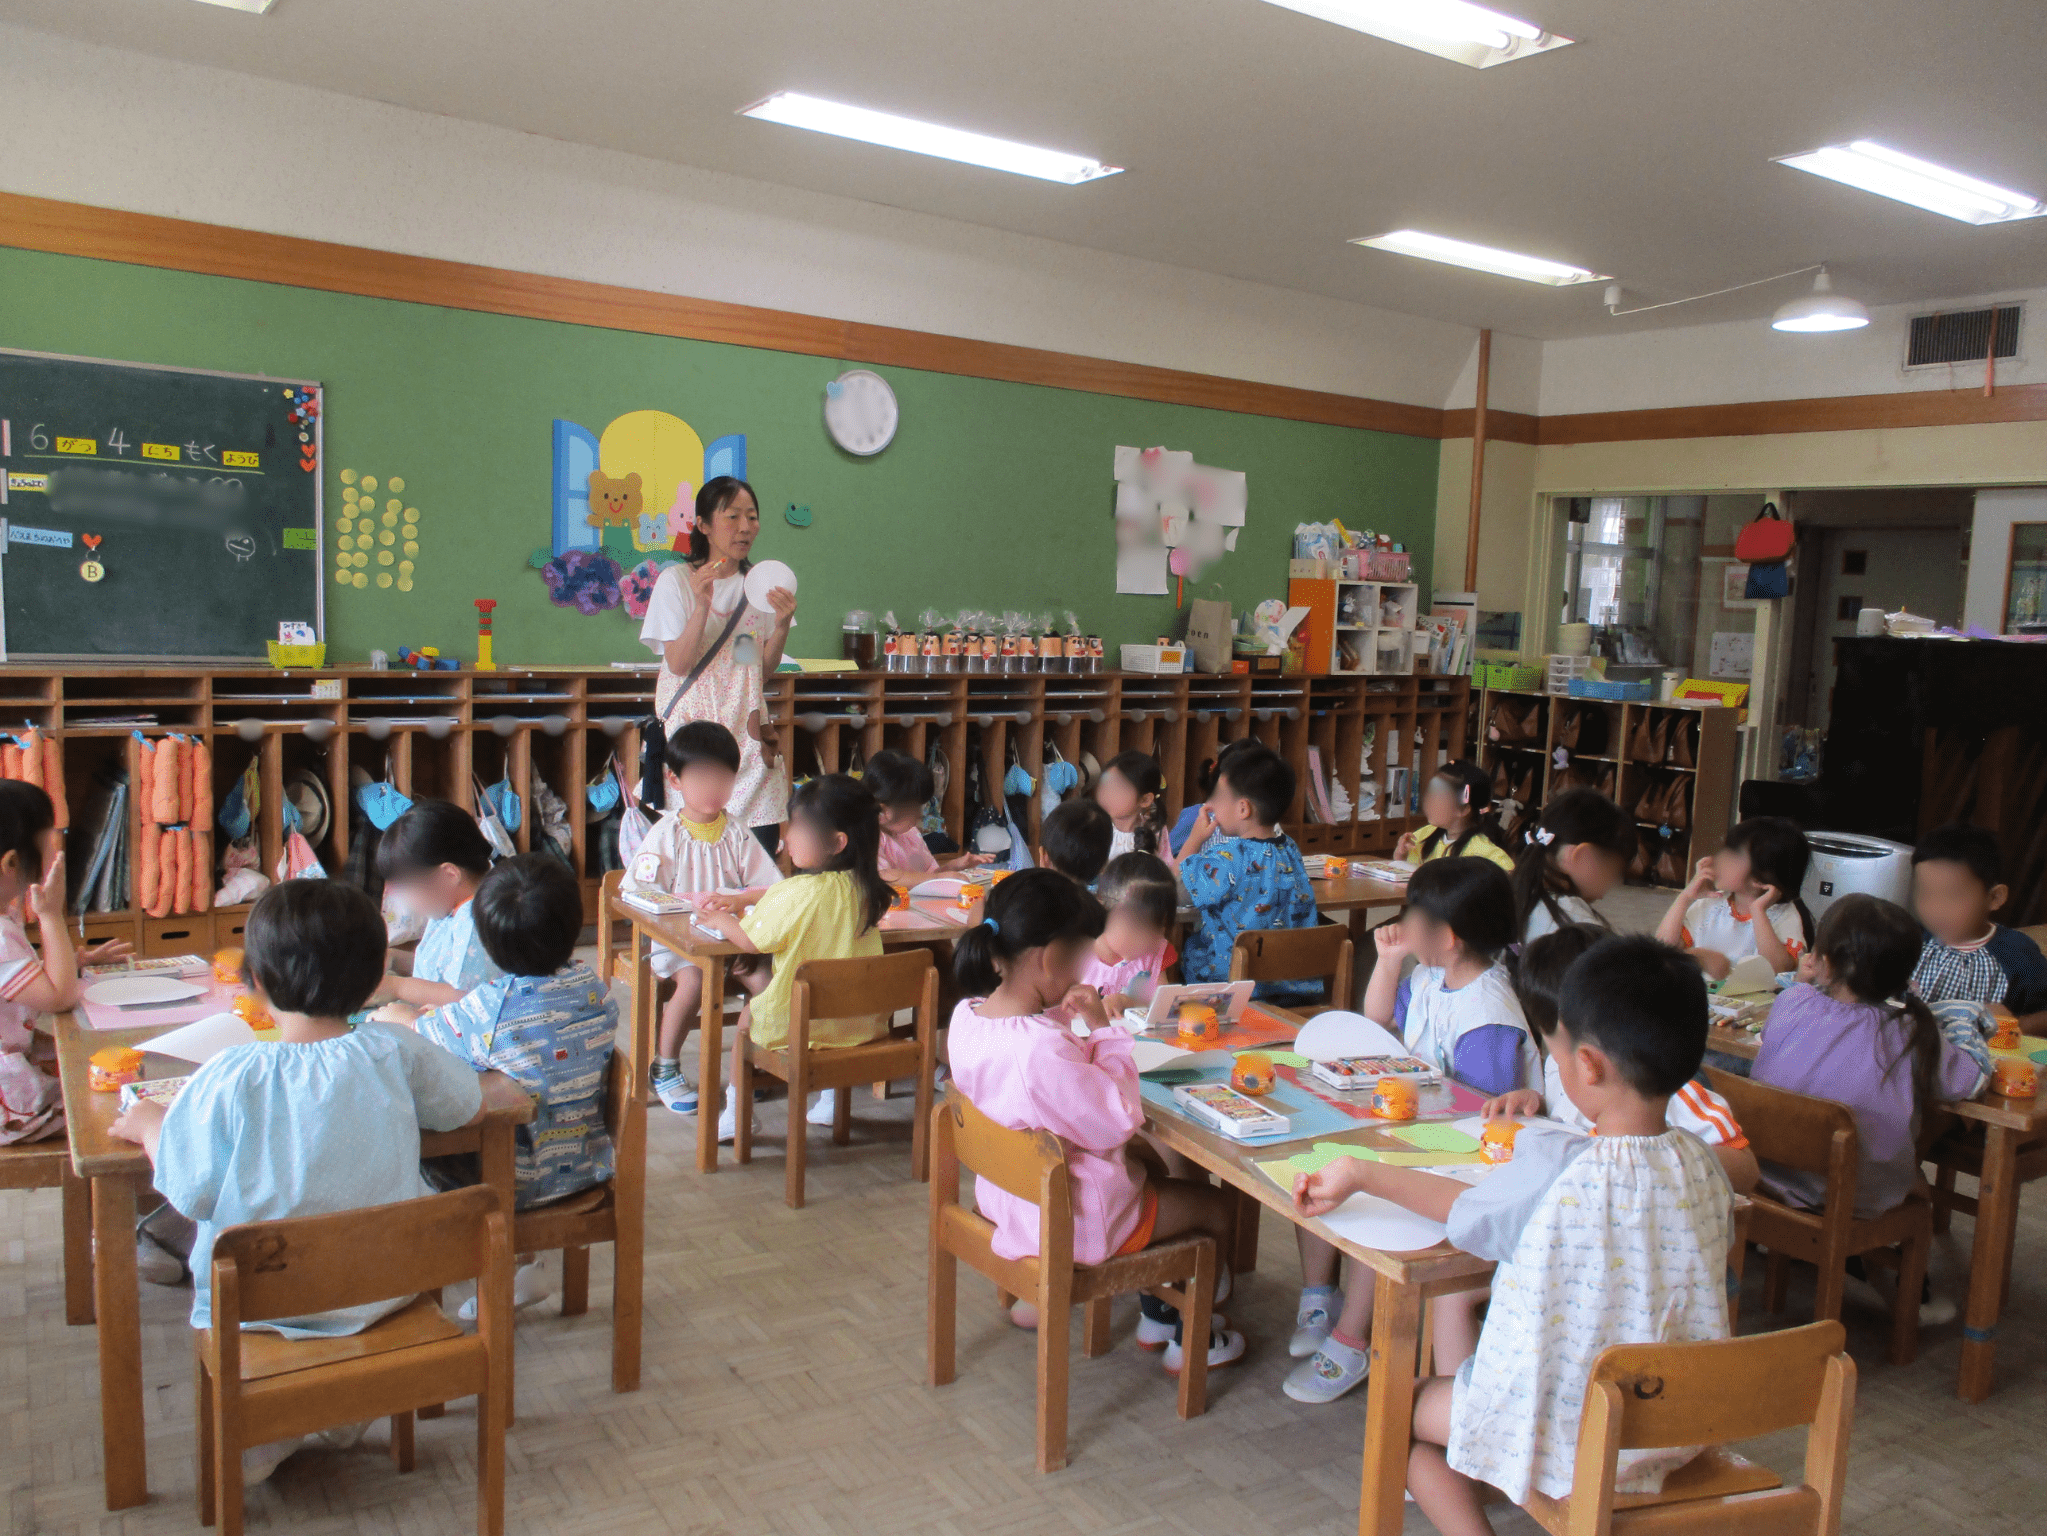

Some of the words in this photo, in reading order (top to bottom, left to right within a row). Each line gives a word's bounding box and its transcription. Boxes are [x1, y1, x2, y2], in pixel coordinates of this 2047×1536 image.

[30, 423, 49, 451] 6
[61, 438, 93, 453] がつ
[107, 427, 131, 455] 4
[147, 445, 174, 458] にち
[183, 440, 219, 463] もく
[225, 453, 260, 466] ようび
[87, 564, 98, 579] B
[1255, 937, 1264, 958] 1
[254, 1234, 288, 1274] 2
